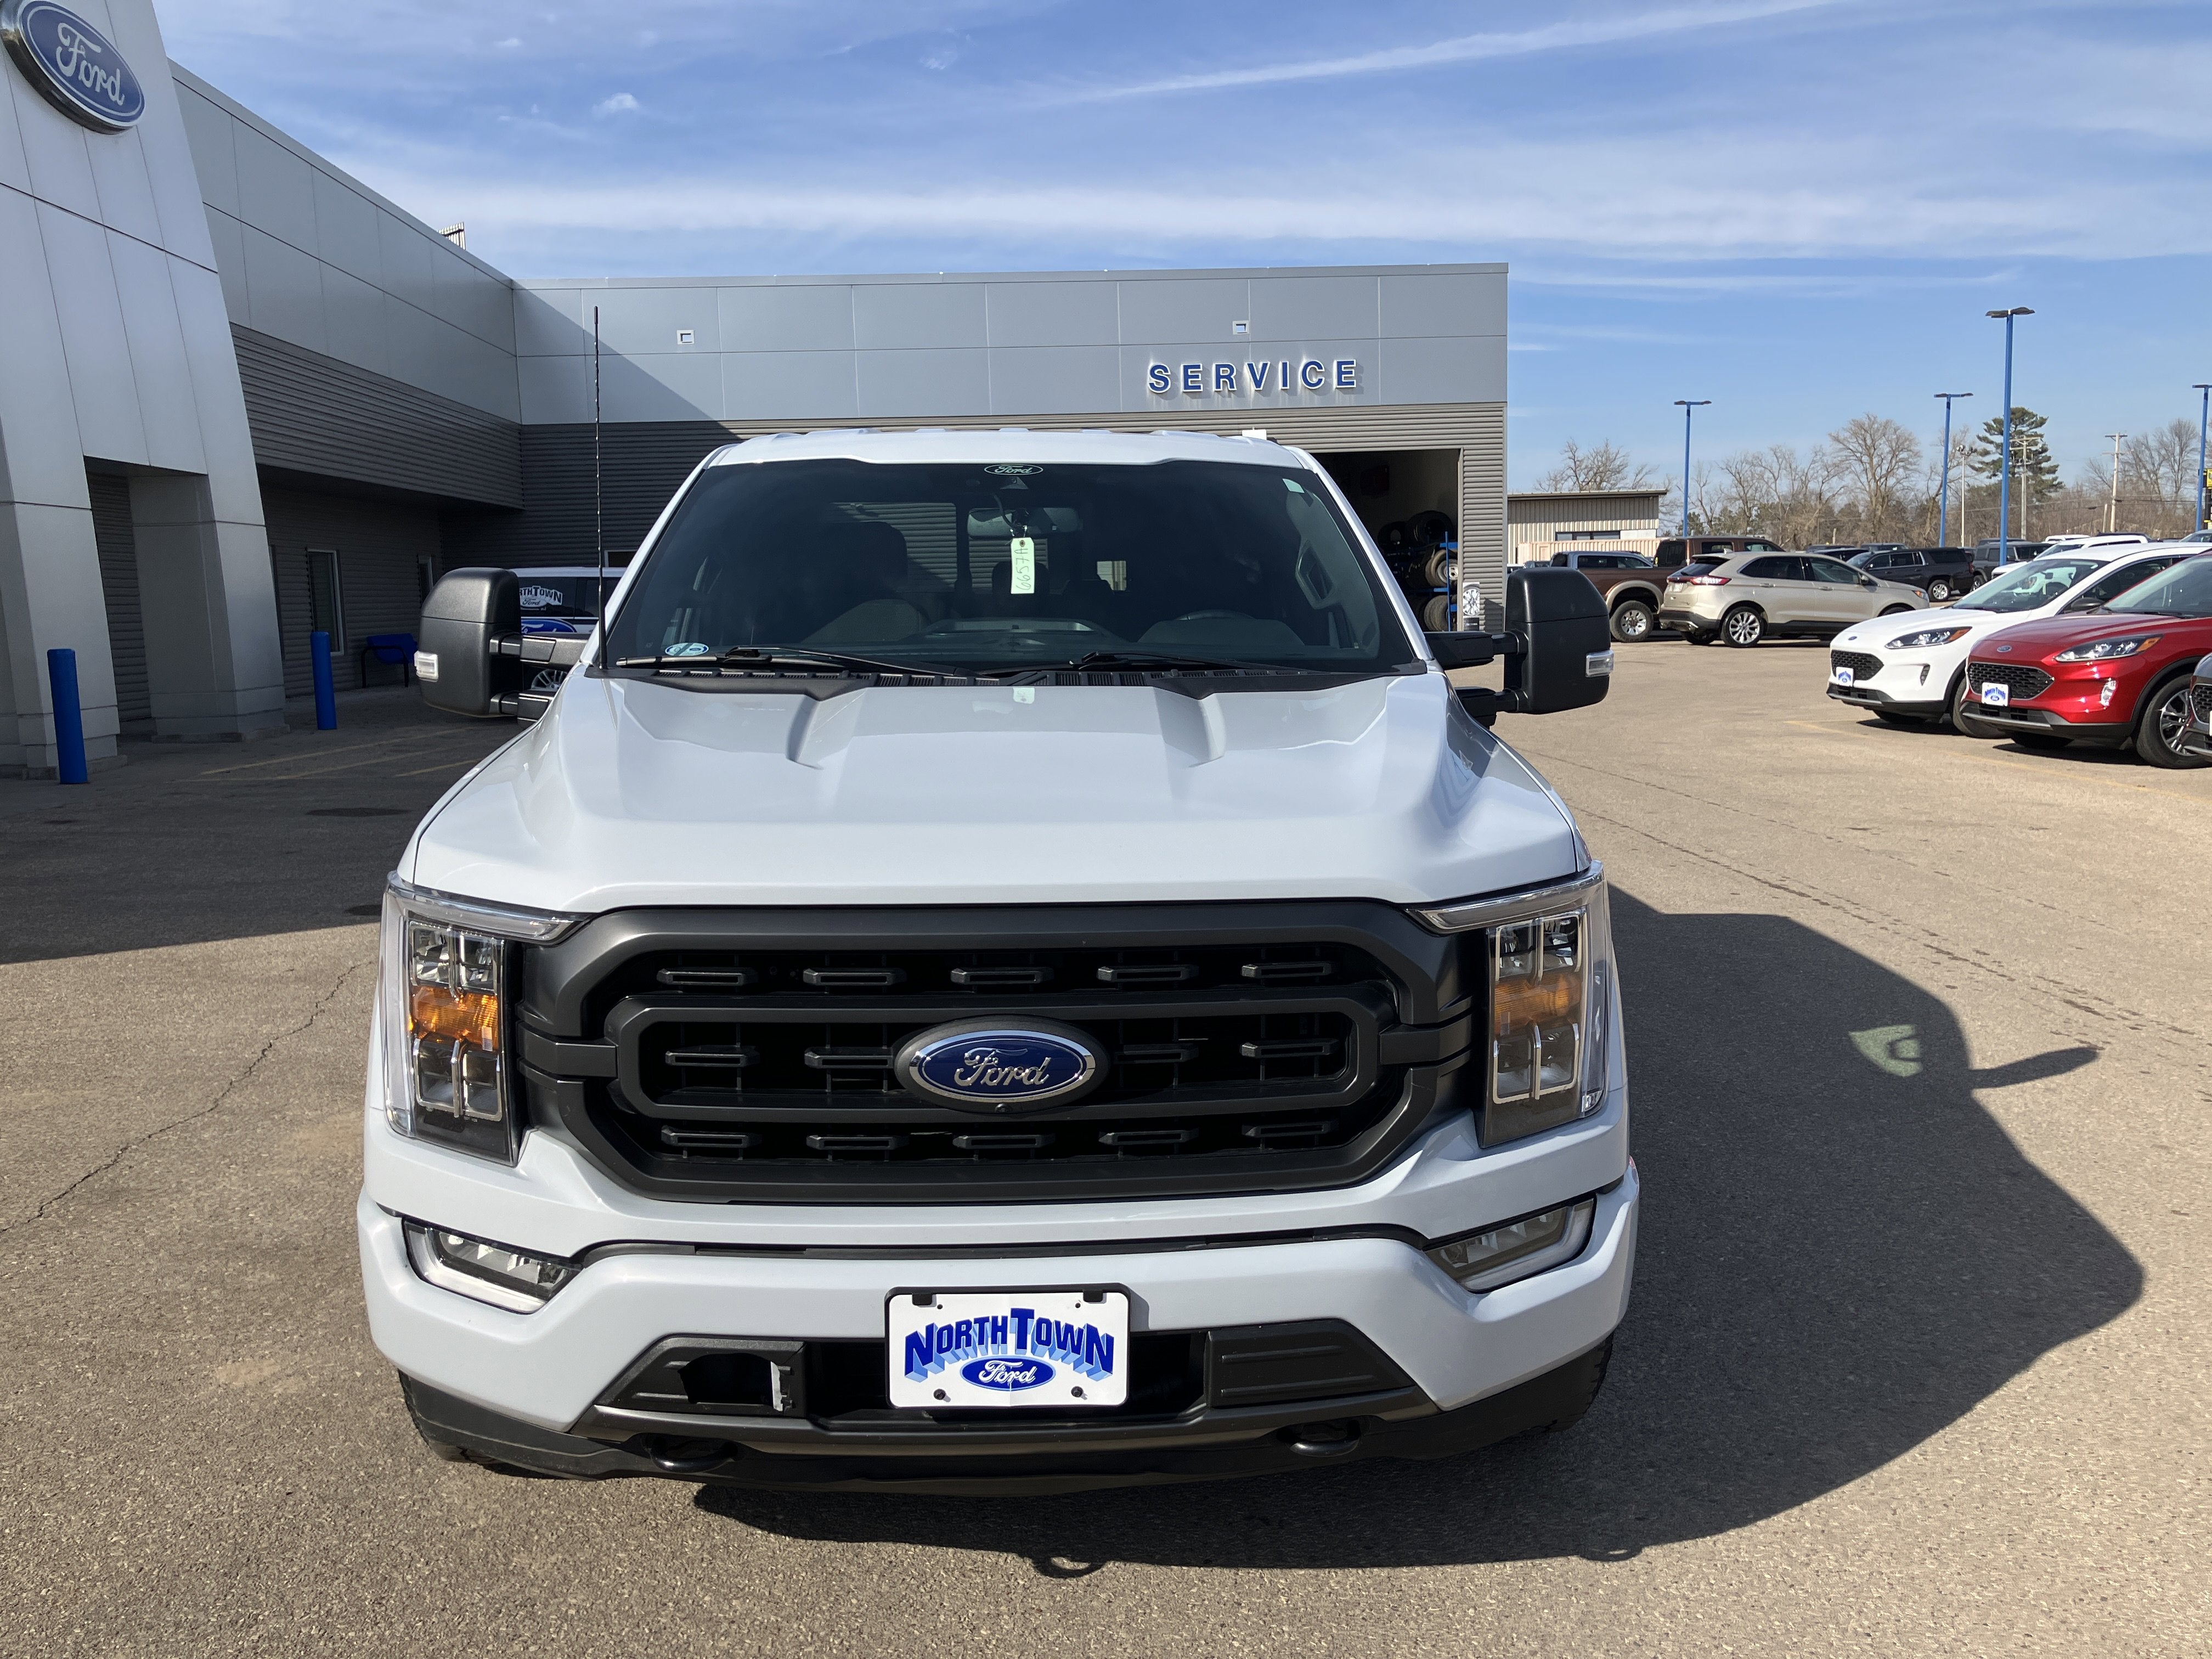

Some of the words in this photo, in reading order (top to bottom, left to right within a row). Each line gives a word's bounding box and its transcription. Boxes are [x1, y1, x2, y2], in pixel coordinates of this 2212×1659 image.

[57, 22, 125, 105] Ford
[1148, 359, 1357, 393] SERVICE
[995, 465, 1032, 473] Ford
[1014, 548, 1031, 590] 6657A
[954, 1047, 1052, 1086] Ford
[978, 1360, 1037, 1384] Ford
